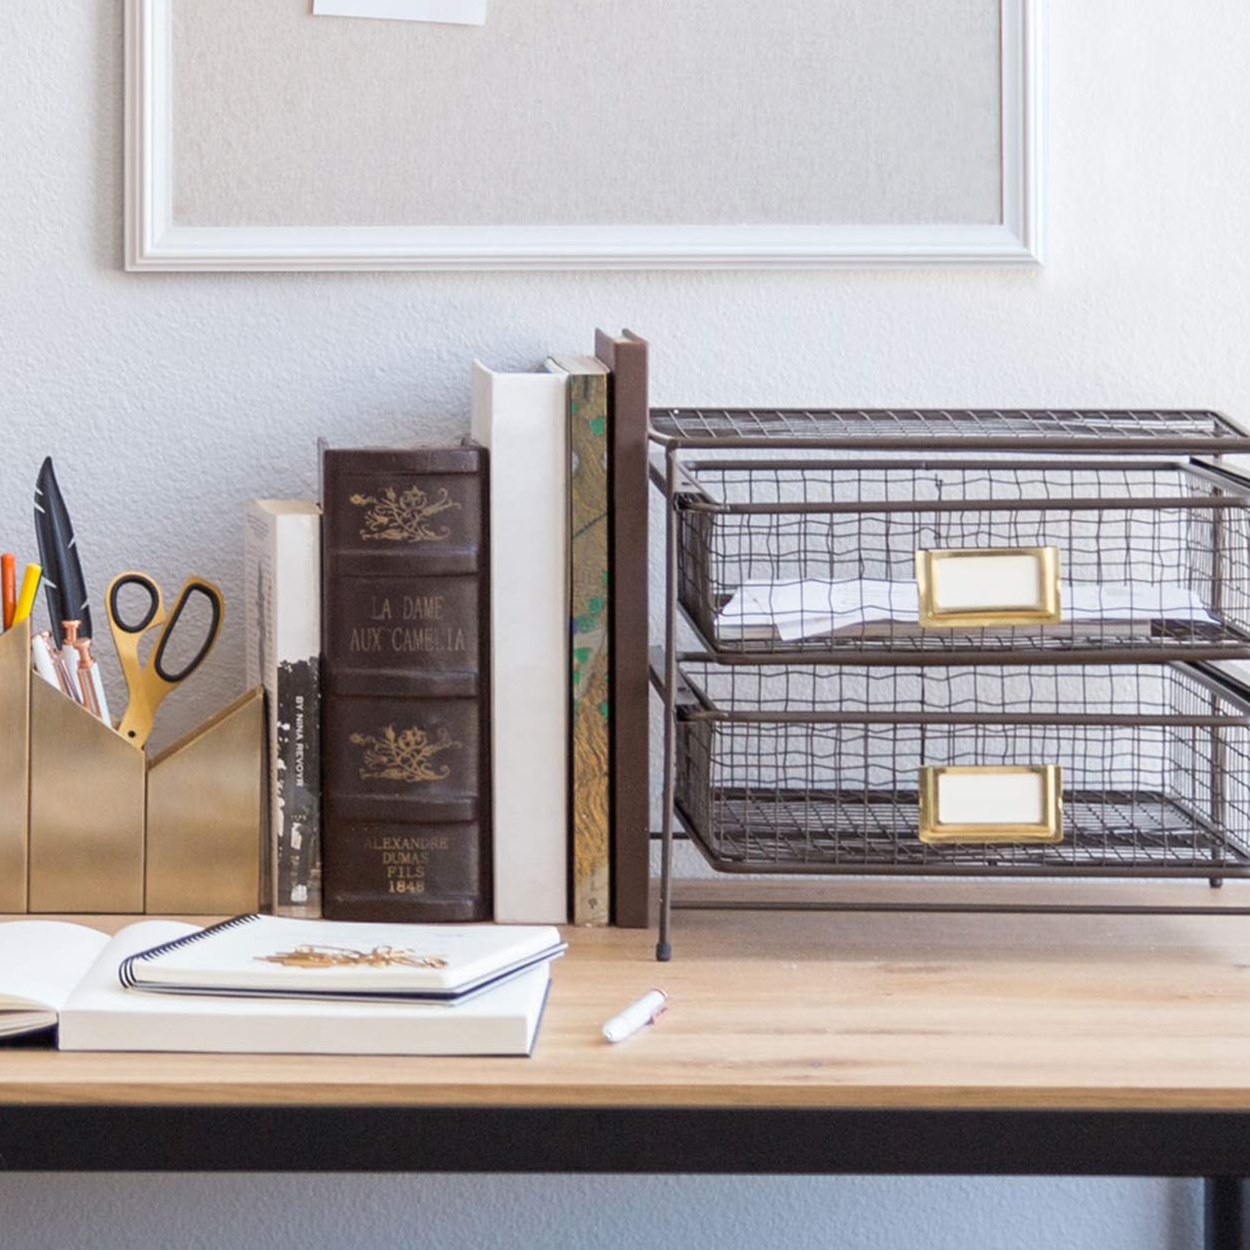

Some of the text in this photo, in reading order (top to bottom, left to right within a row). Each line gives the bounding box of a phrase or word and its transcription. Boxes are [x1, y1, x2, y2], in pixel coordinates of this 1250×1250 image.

[367, 596, 445, 620] LA DAME
[349, 627, 382, 651] AUX
[295, 696, 304, 711] BY
[382, 851, 430, 864] DUMAS
[387, 865, 425, 879] FILS
[388, 880, 425, 893] 1848
